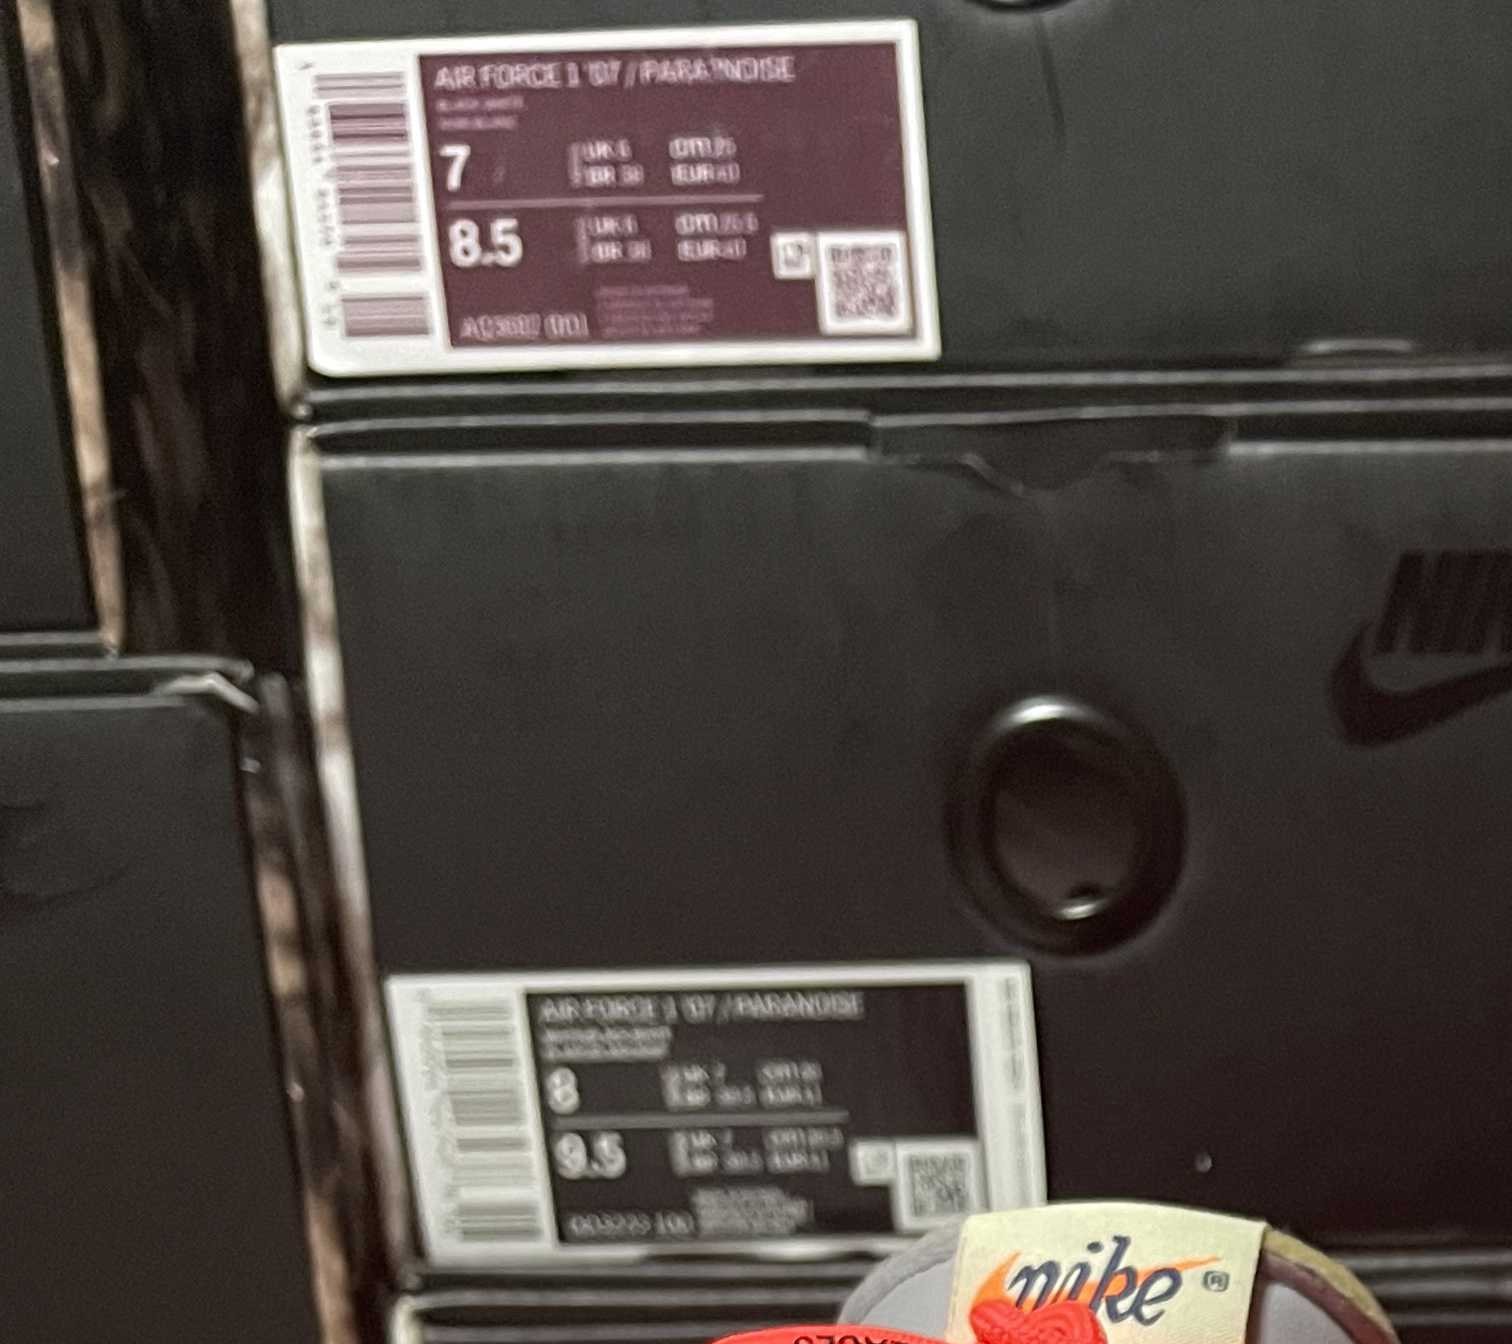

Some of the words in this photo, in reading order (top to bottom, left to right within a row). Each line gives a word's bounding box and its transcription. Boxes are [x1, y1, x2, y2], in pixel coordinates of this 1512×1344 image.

[439, 144, 471, 192] 7
[448, 217, 524, 268] 8.5
[1008, 1234, 1183, 1327] nike
